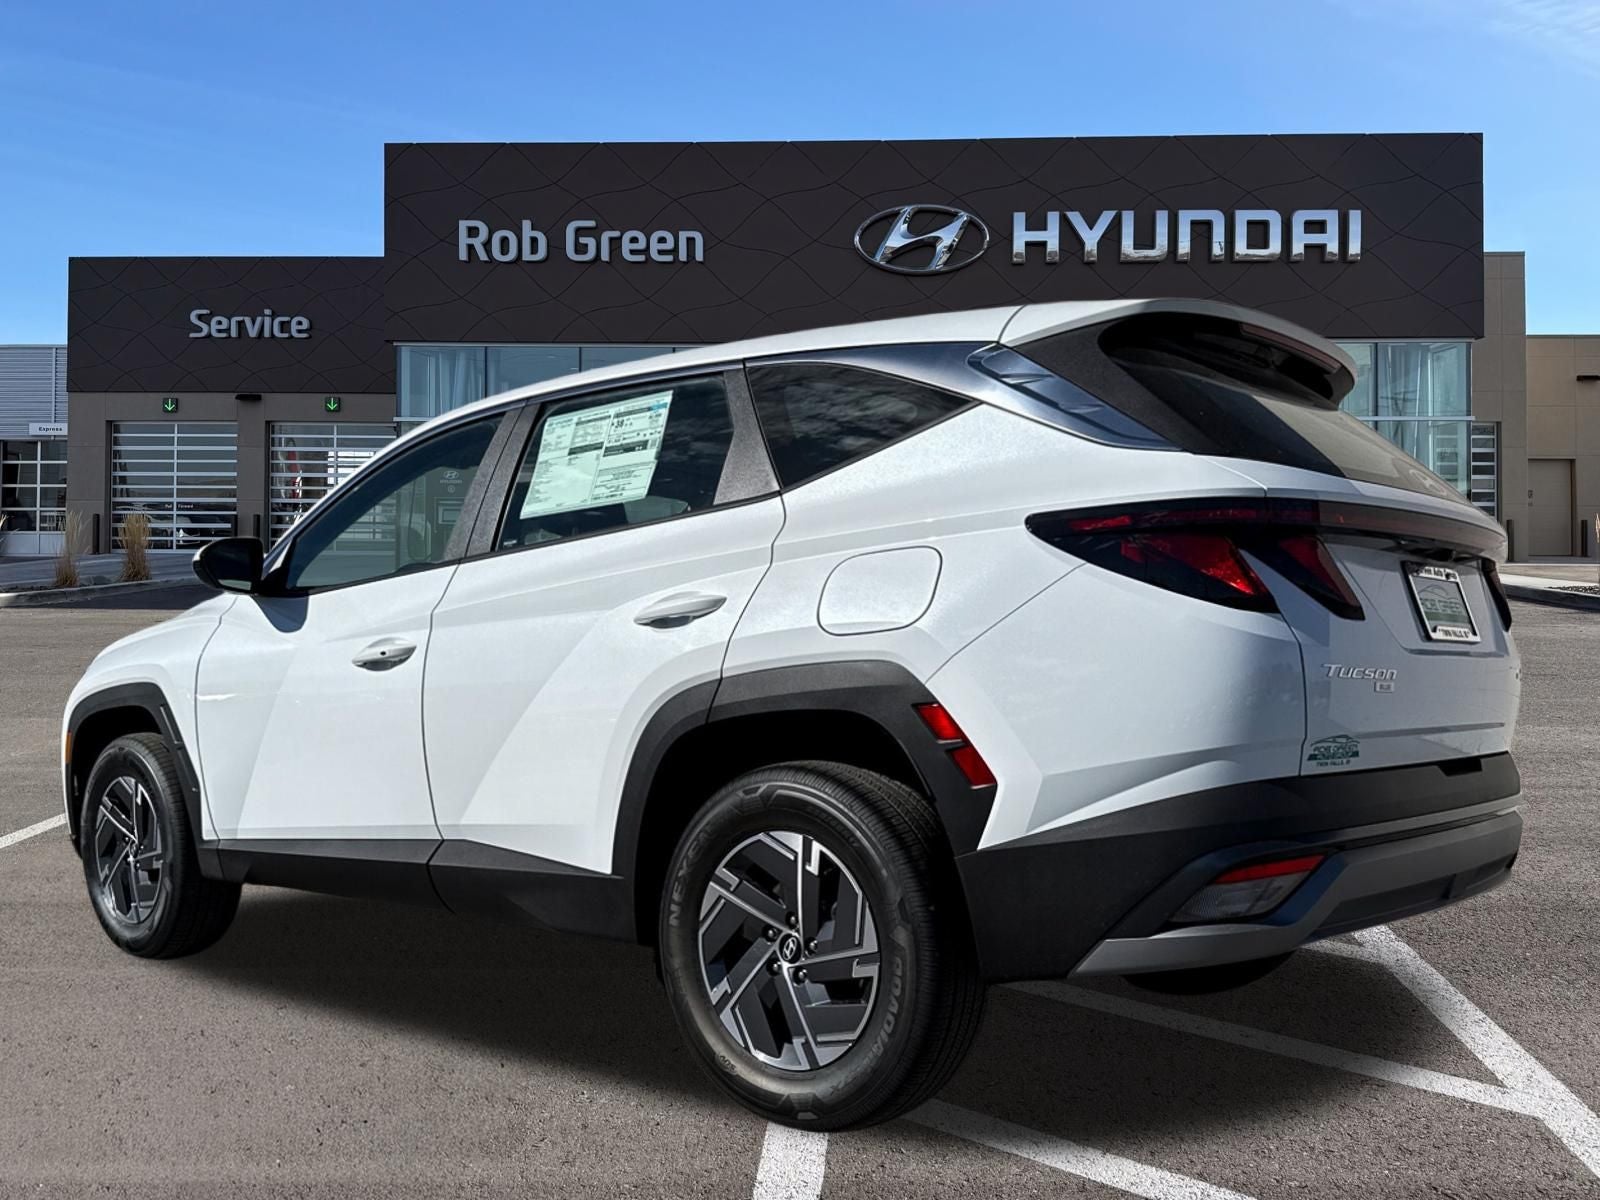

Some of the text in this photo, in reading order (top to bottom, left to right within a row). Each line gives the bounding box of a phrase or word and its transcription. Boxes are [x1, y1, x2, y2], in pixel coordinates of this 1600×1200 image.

[458, 219, 705, 262] Rob Green
[1011, 209, 1362, 264] HYUNDAI
[189, 308, 311, 338] Service
